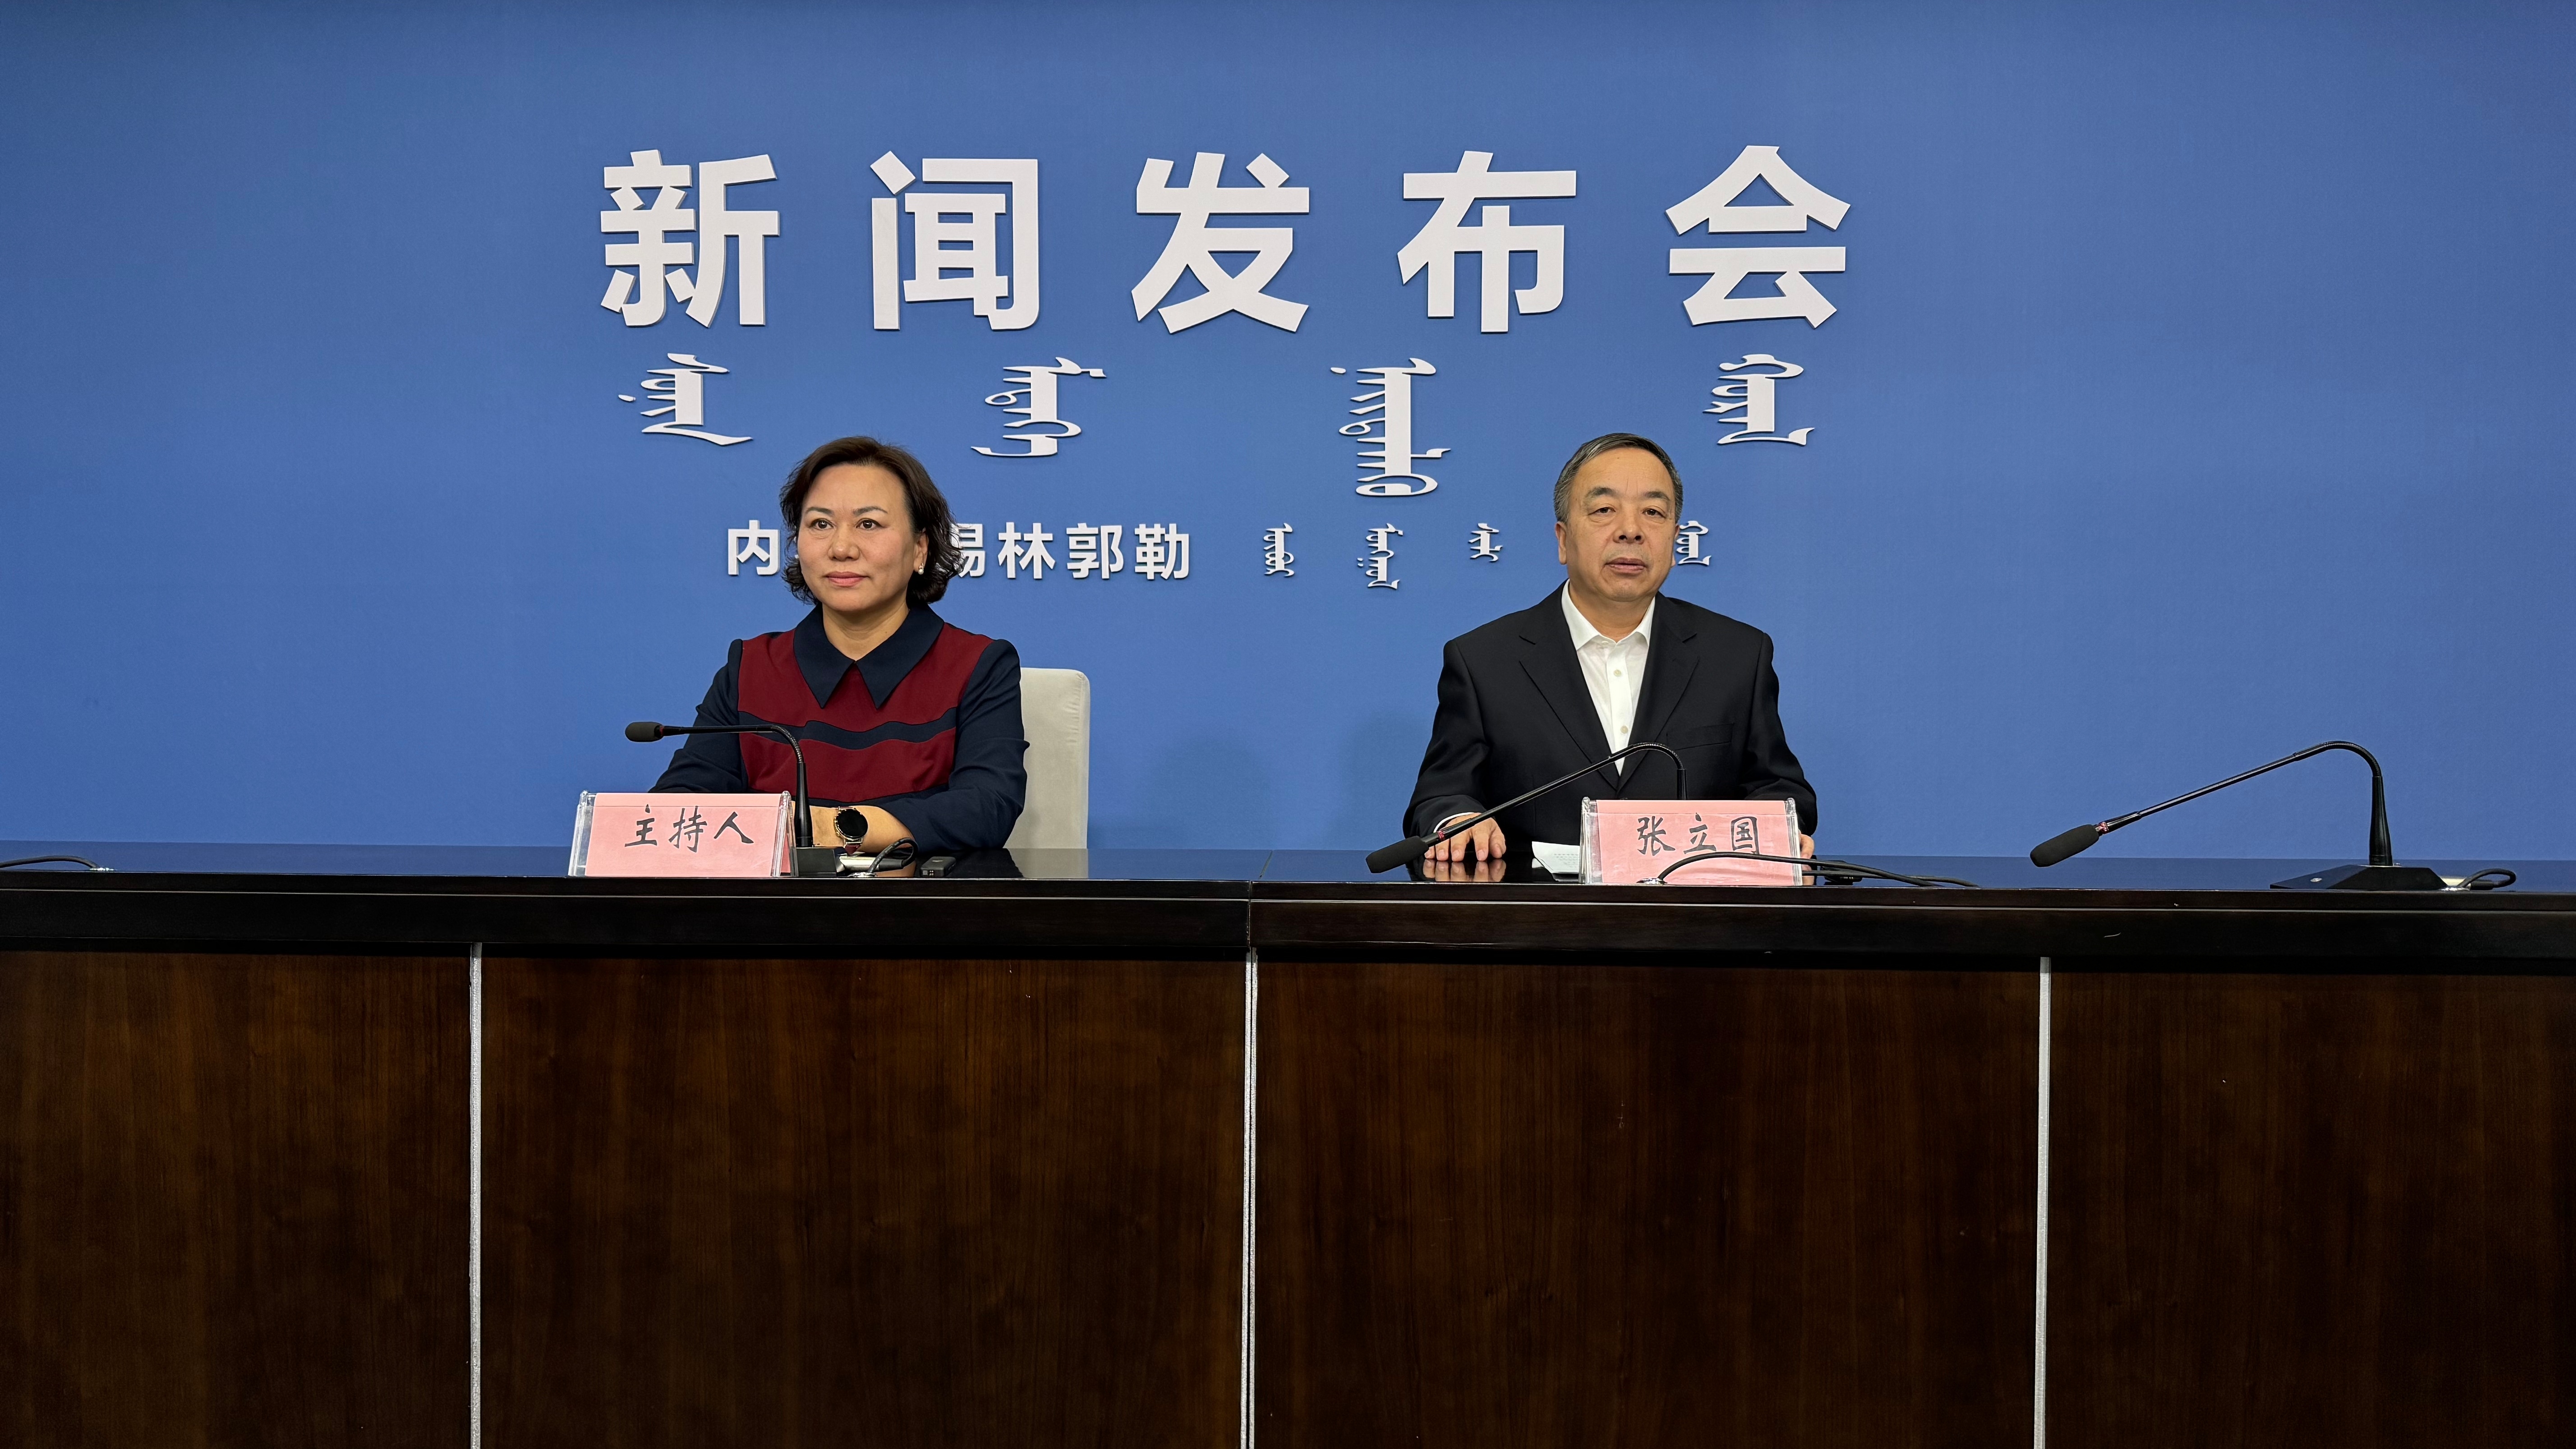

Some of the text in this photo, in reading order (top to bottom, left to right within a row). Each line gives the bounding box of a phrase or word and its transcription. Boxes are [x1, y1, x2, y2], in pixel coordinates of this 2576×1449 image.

[601, 145, 1851, 334] 新闻发布会
[625, 804, 754, 852] 主持人
[1637, 813, 1759, 856] 张立国
